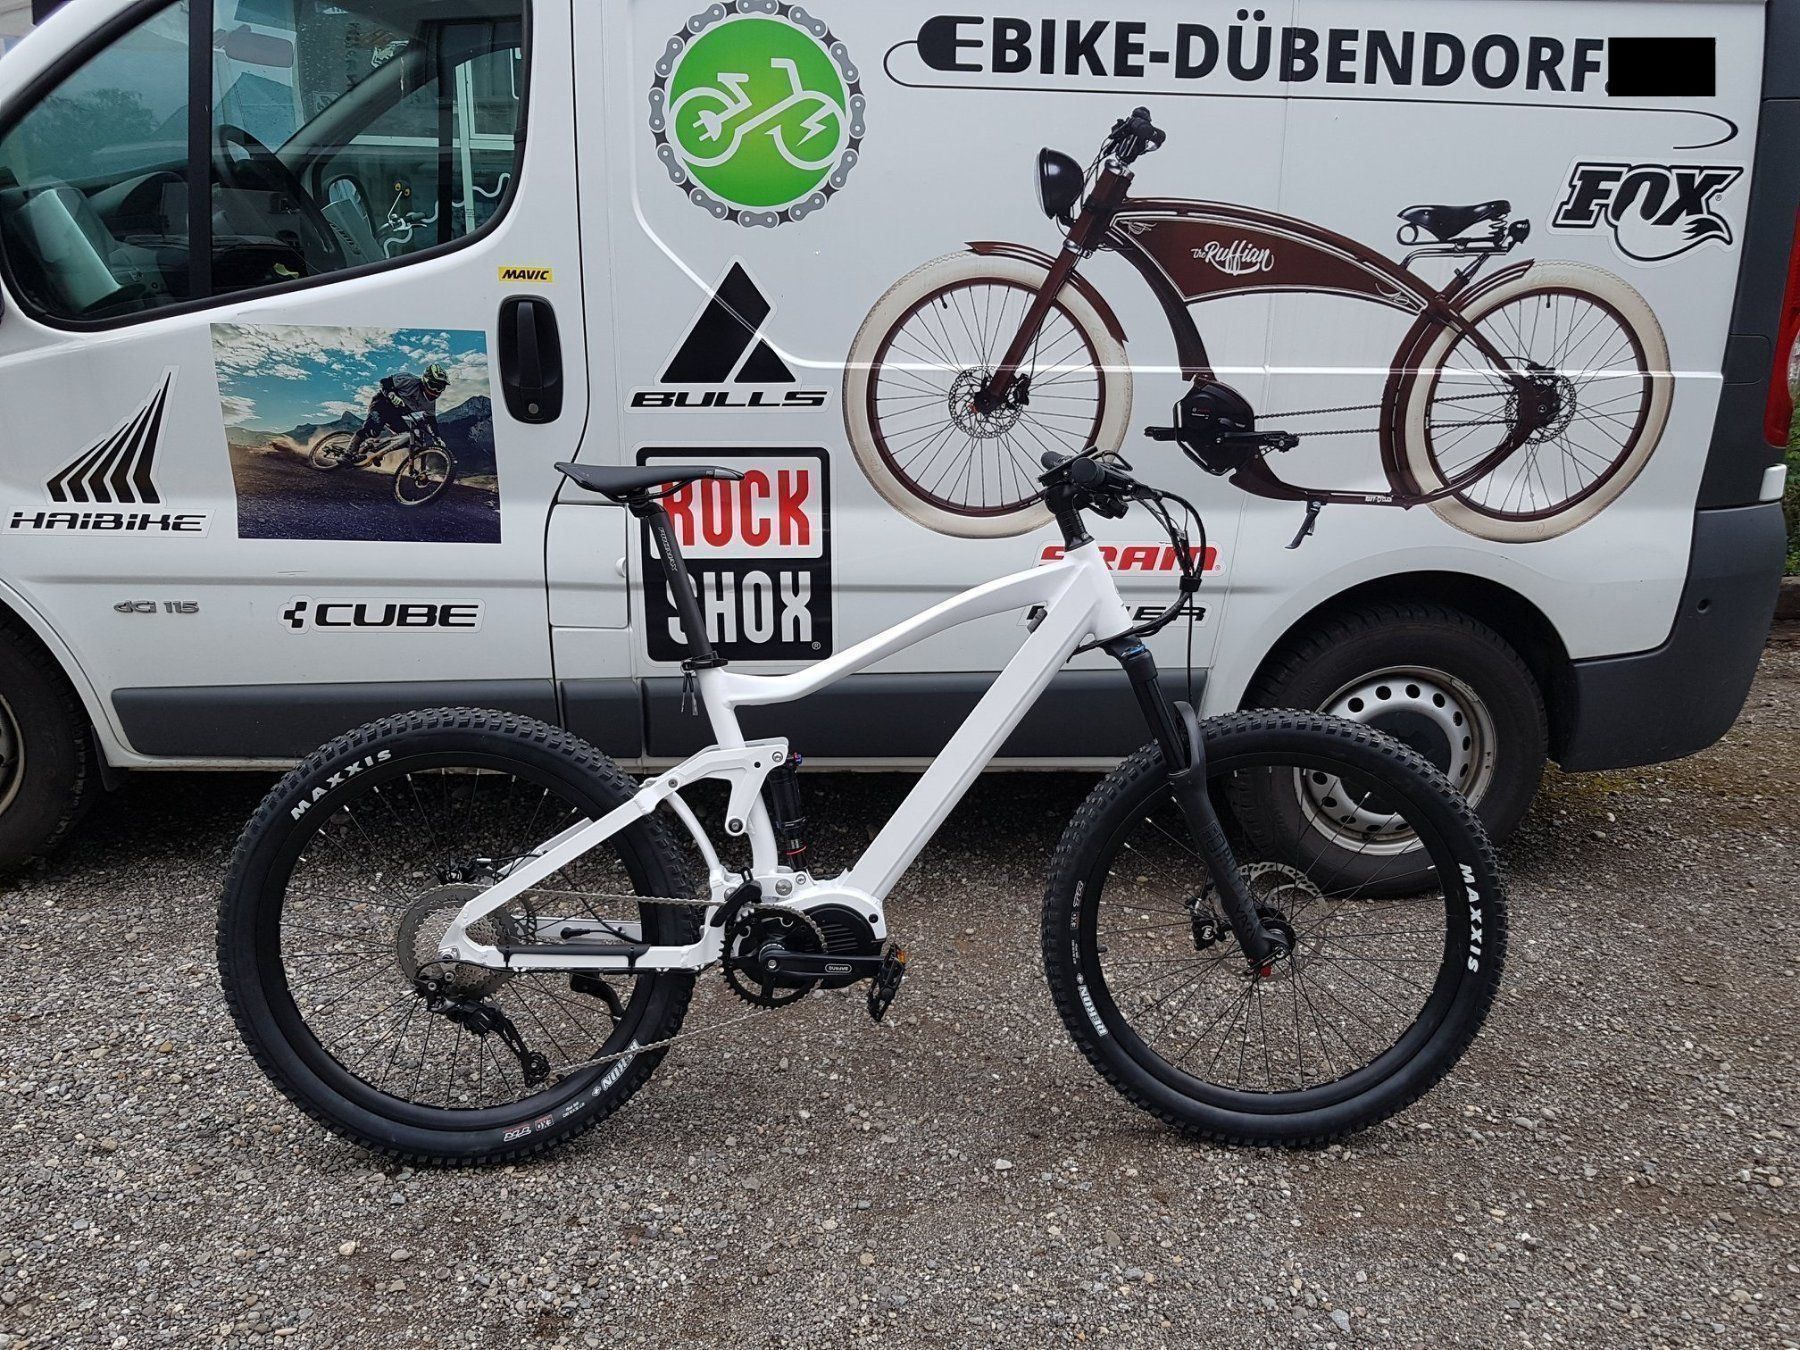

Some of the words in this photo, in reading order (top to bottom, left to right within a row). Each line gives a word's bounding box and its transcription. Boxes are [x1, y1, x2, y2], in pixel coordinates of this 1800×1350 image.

[1552, 162, 1744, 235] FOX
[502, 269, 549, 280] MAVIC
[1204, 240, 1274, 276] Ruffian
[630, 391, 828, 408] BULLS
[660, 470, 811, 547] ROCK
[163, 601, 200, 614] 115
[315, 603, 479, 627] CUBE
[290, 749, 392, 821] MAXXIS
[1459, 863, 1483, 973] MAXXIS
